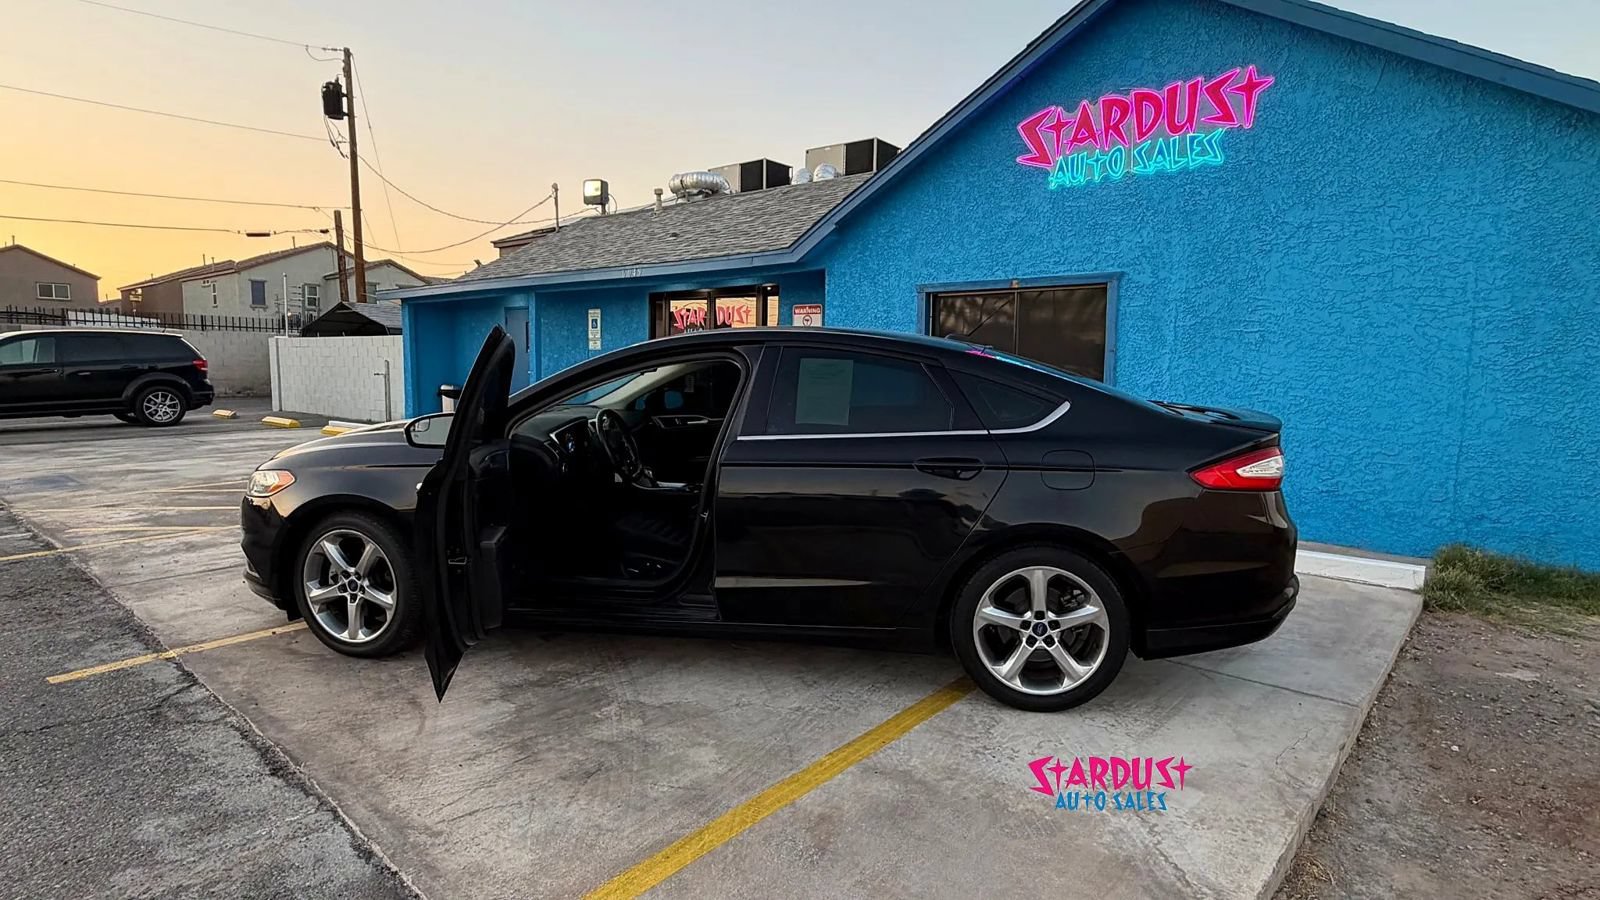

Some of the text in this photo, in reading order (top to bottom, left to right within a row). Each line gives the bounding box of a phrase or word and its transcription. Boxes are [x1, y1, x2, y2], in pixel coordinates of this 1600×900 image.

[1016, 65, 1274, 167] STARDUST
[1048, 128, 1226, 189] AUTO SALES
[716, 304, 752, 326] DUST
[794, 306, 821, 314] WARNING
